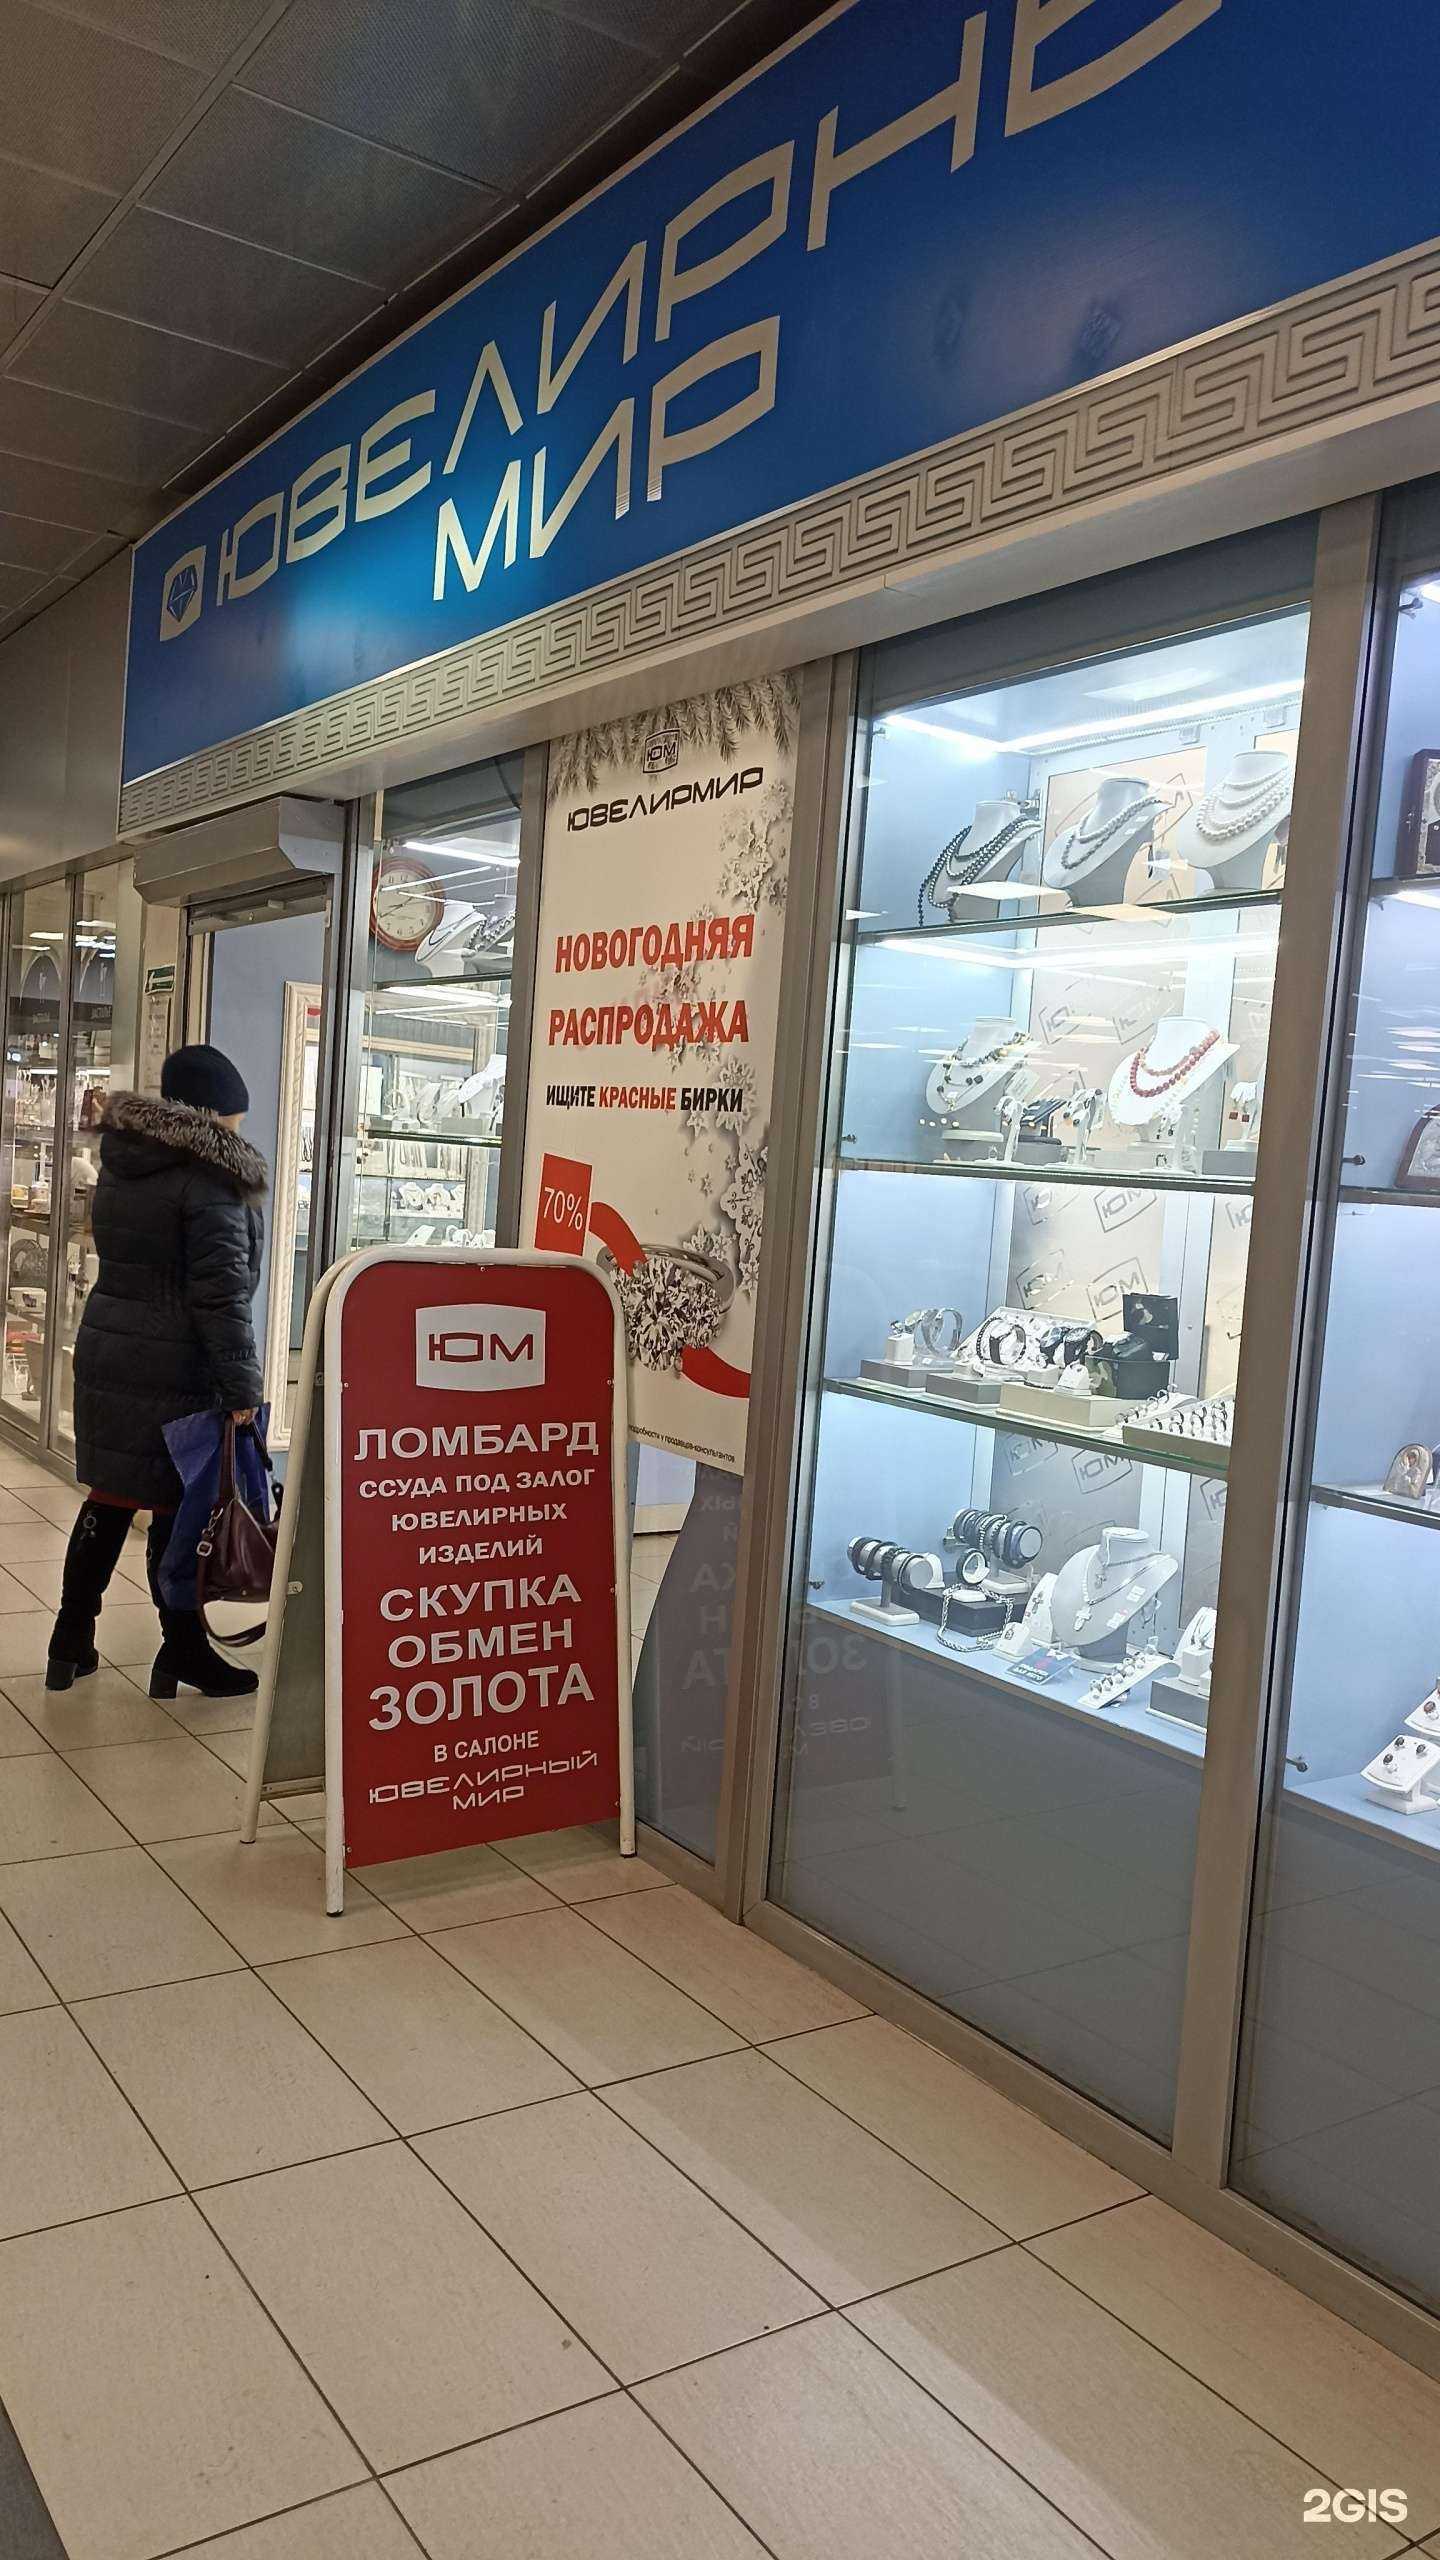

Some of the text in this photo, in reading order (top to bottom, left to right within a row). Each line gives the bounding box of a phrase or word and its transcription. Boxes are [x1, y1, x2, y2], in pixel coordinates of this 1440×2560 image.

[433, 315, 780, 601] МИР
[646, 741, 677, 762] ЮМ
[567, 766, 764, 832] ЮВЕЛИРМИР
[554, 913, 756, 974] НОВОГОДНЯЯ
[548, 999, 750, 1052] РАСПРОДАЖА
[545, 1084, 744, 1113] ИЩИТЕ КРАСНЫЕ БИРКИ
[543, 1186, 583, 1232] 70%
[428, 1332, 534, 1363] ЮМ
[353, 1421, 599, 1461] ЛОМБАРД
[358, 1468, 596, 1499] ССУДА ПОД ЗАЛОГ
[391, 1502, 568, 1532] ЮВЕЛИРНЫХ
[418, 1533, 543, 1565] ИЗДЕЛИЙ
[379, 1573, 582, 1622] СКУПКА
[387, 1617, 573, 1669] ОБМЕН
[368, 1662, 595, 1731] ЗОЛОТА
[433, 1730, 540, 1763] В САЛОНЕ
[368, 1749, 598, 1804] ЮВЕЛИРНЫЙ
[452, 1785, 525, 1810] МИР
